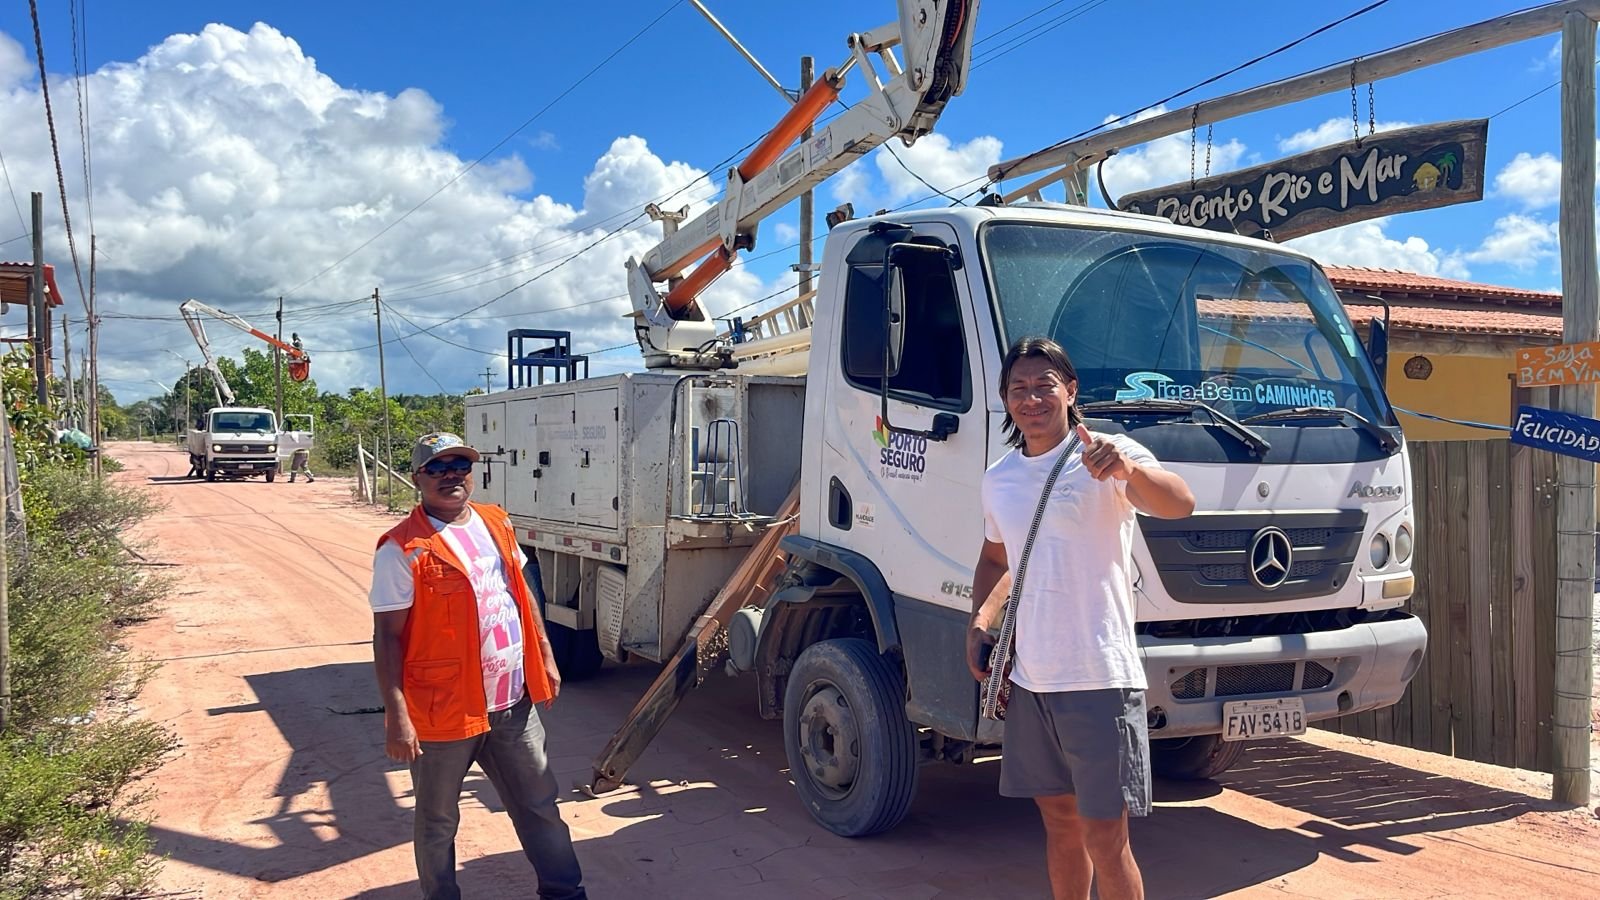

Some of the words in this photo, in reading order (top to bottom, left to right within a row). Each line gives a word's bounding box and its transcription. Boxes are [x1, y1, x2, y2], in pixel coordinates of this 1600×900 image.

[1259, 172, 1311, 223] Rio
[1317, 174, 1333, 194] e
[1340, 148, 1407, 208] Mar
[1521, 367, 1564, 384] BEM
[1255, 383, 1336, 409] CAMINHÕES
[889, 431, 927, 455] PORTO
[1515, 413, 1600, 452] FELICIDAD
[880, 447, 925, 473] SEGURO
